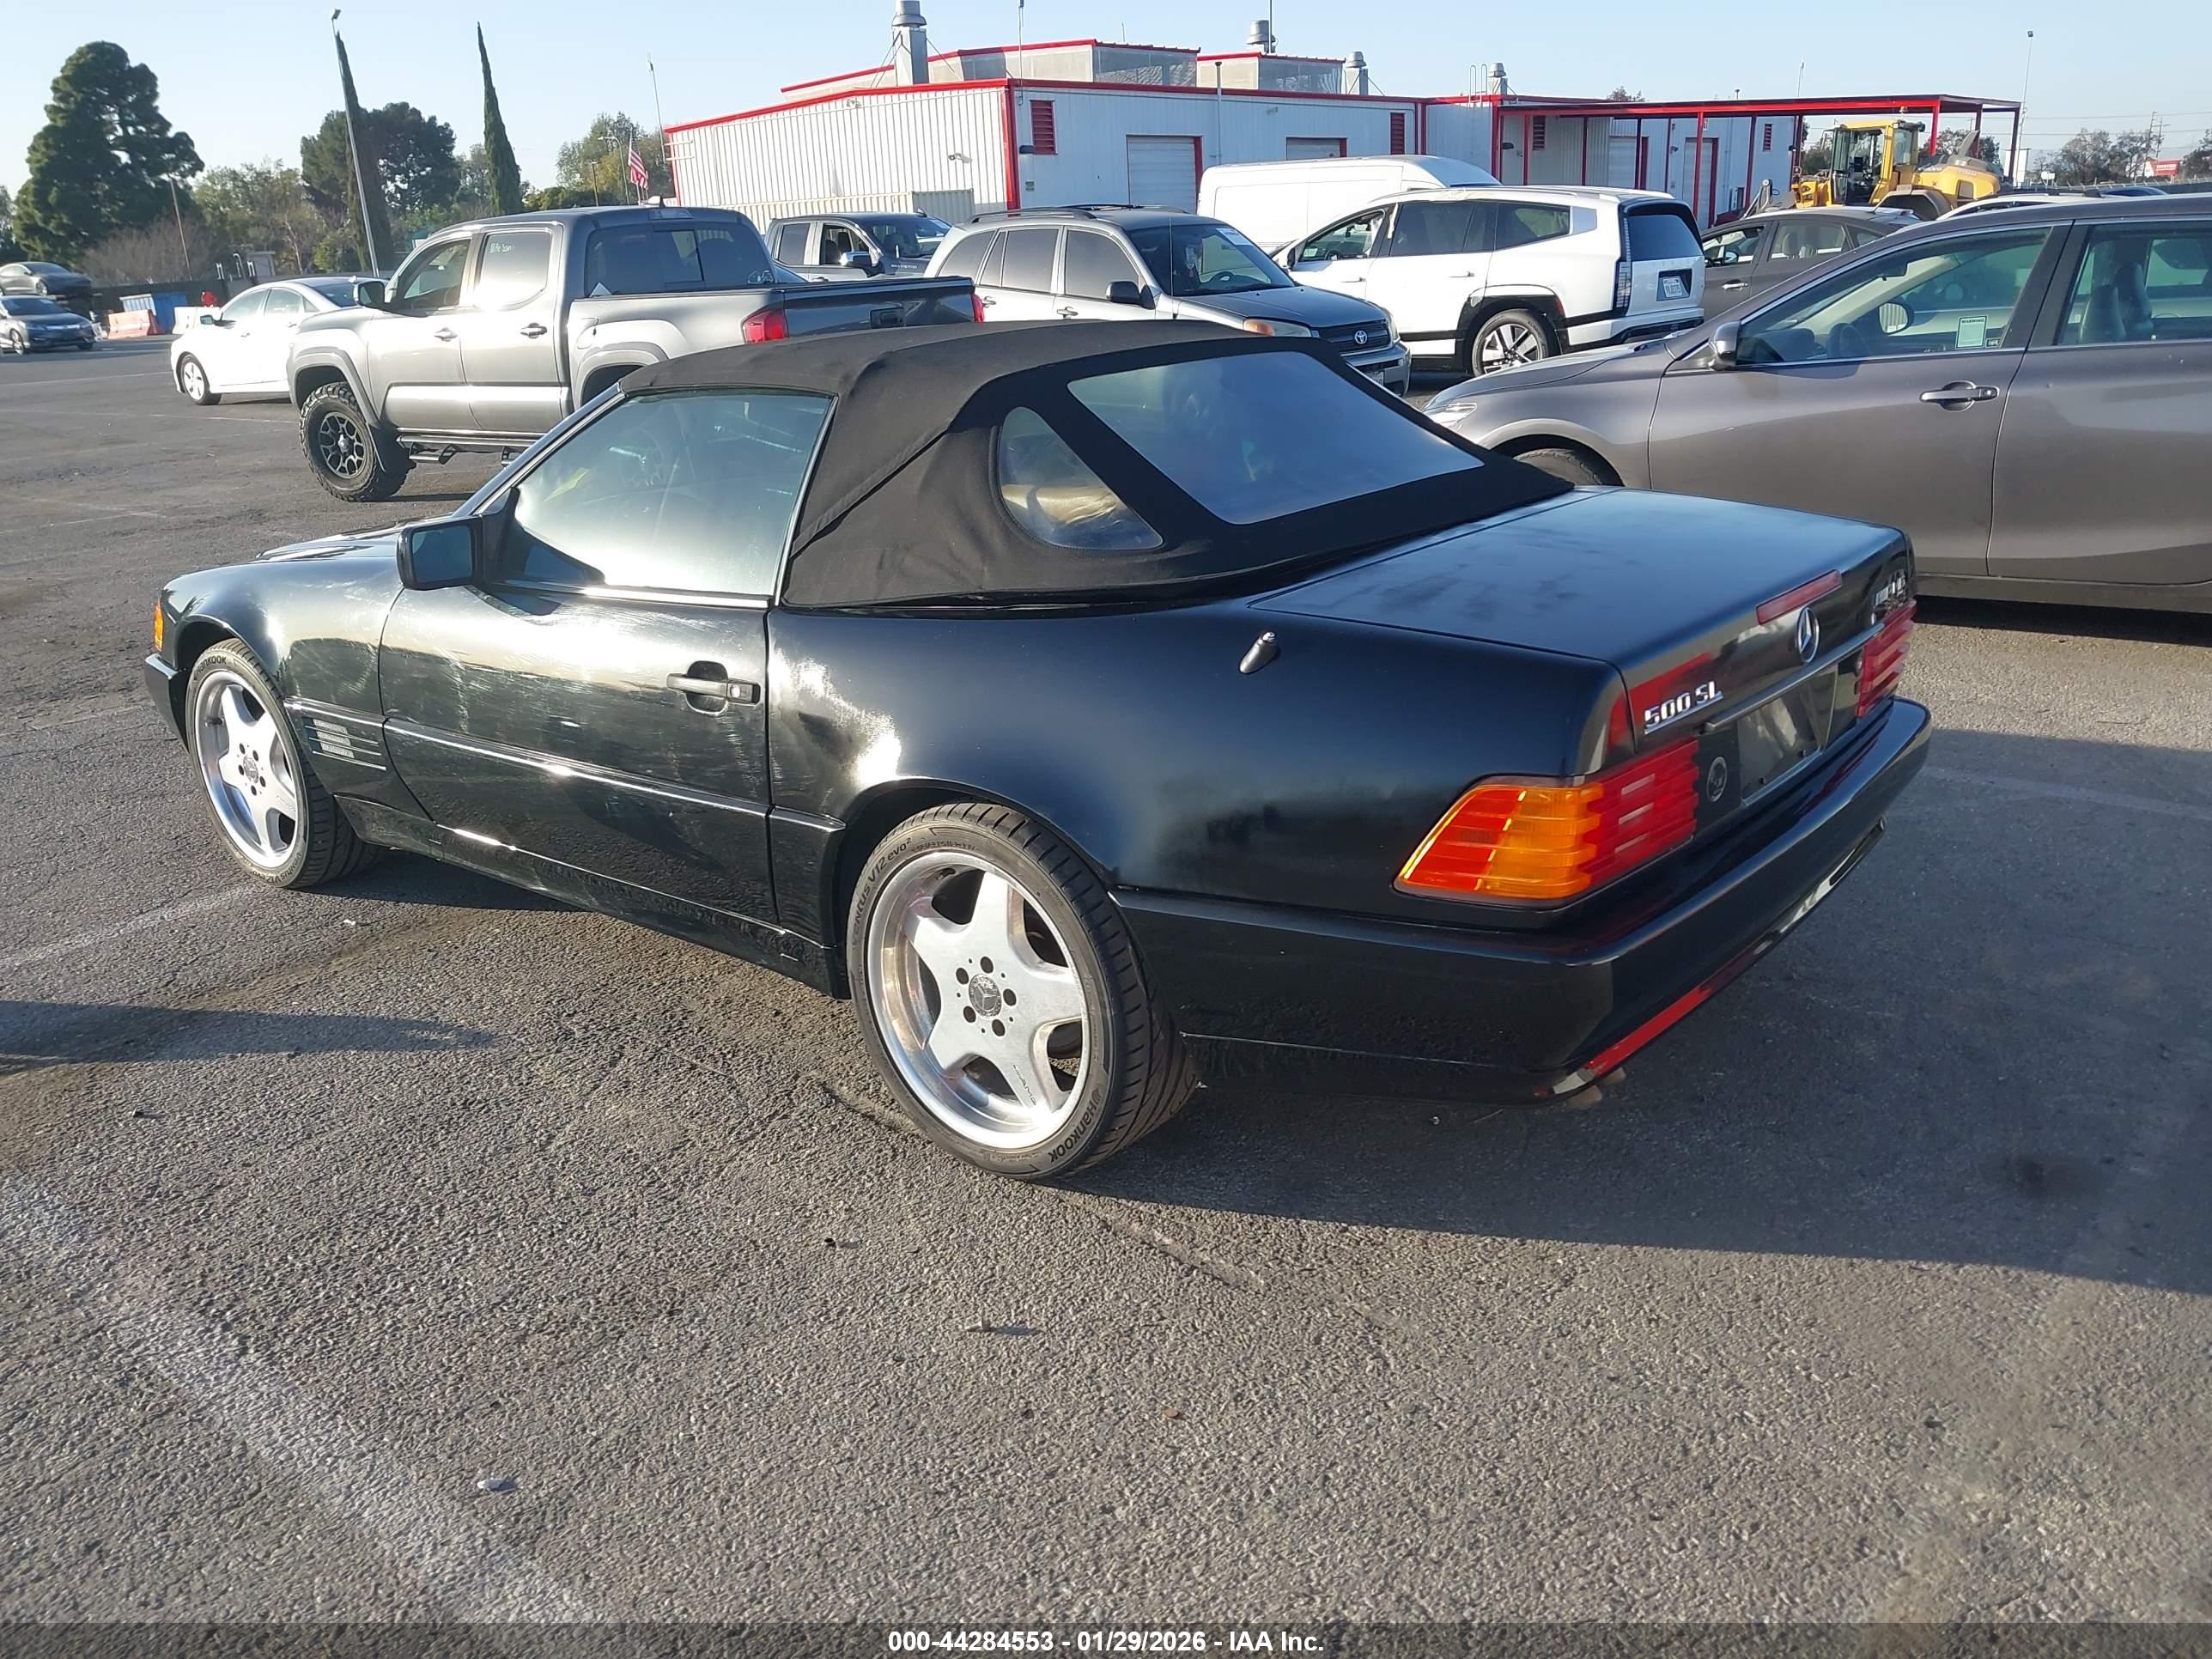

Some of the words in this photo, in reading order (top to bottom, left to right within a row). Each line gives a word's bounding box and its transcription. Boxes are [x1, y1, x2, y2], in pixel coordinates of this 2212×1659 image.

[1644, 692, 1691, 727] 500
[1695, 680, 1723, 704] SL
[868, 857, 886, 884] V12
